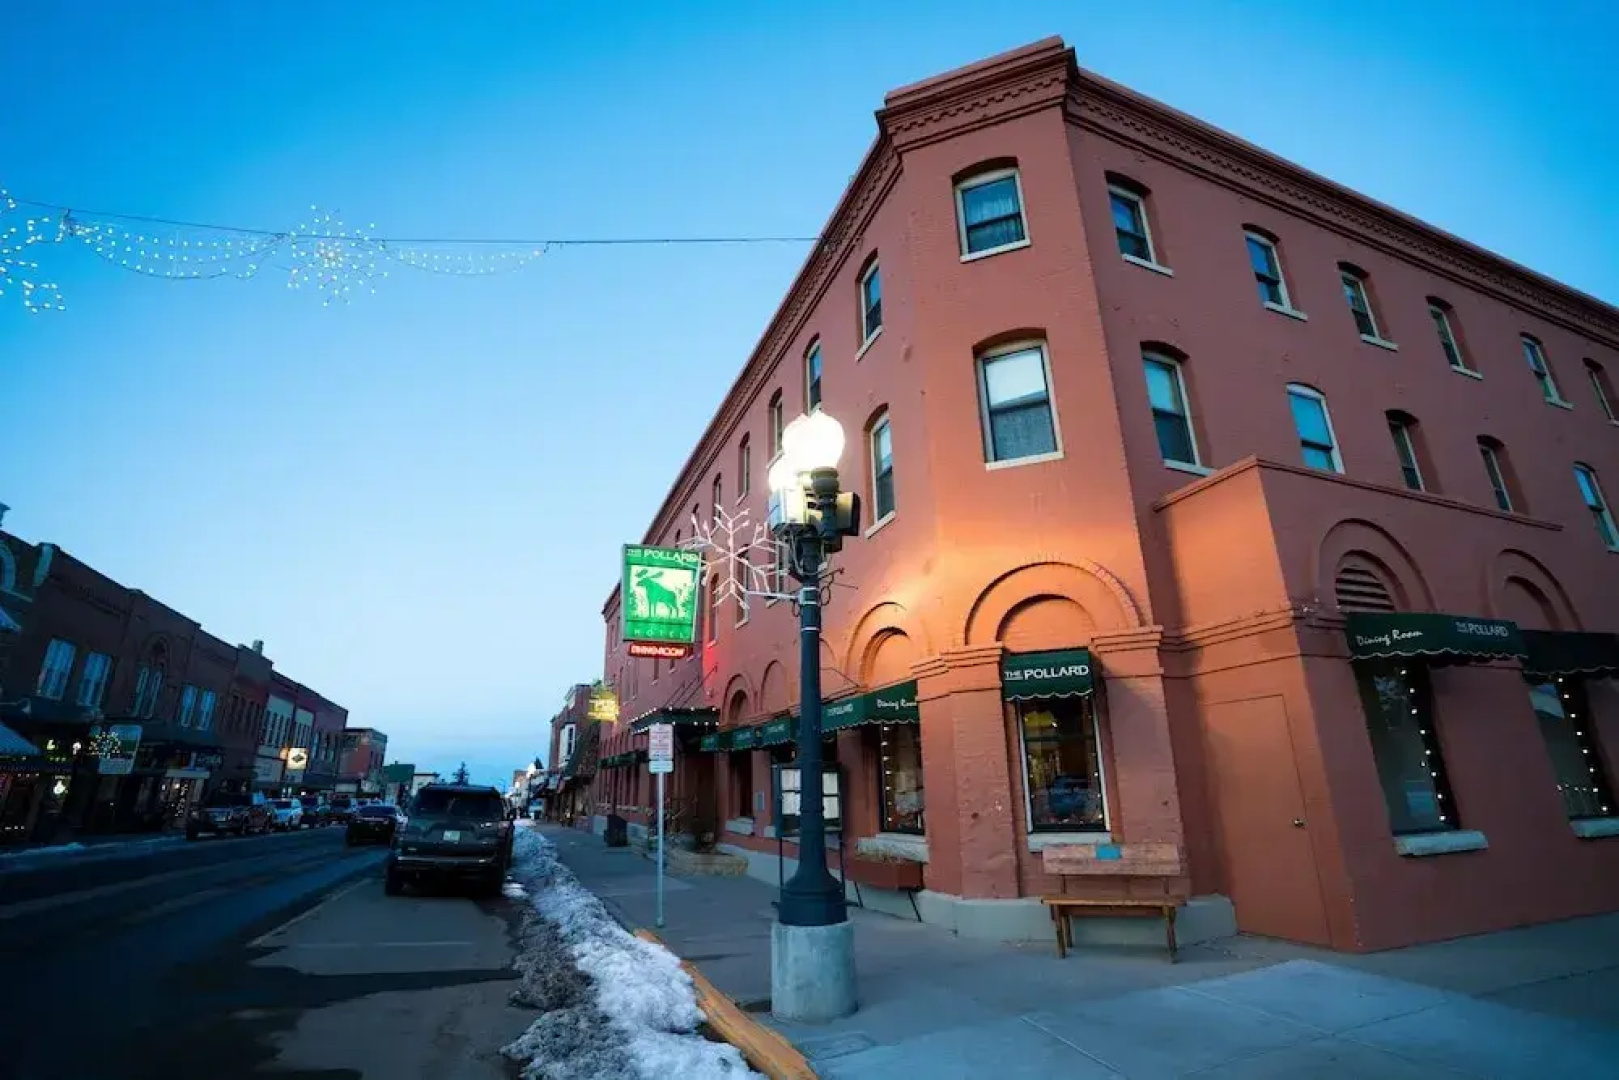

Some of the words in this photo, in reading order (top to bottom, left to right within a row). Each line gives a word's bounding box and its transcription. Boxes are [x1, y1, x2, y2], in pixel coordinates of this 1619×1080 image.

[644, 550, 699, 562] POLLARD
[634, 629, 684, 639] HOTEL
[1467, 622, 1510, 637] POLLARD
[1356, 634, 1391, 646] Dining
[1392, 629, 1423, 640] Room
[1004, 670, 1023, 681] THE
[1024, 665, 1089, 680] POLLARD
